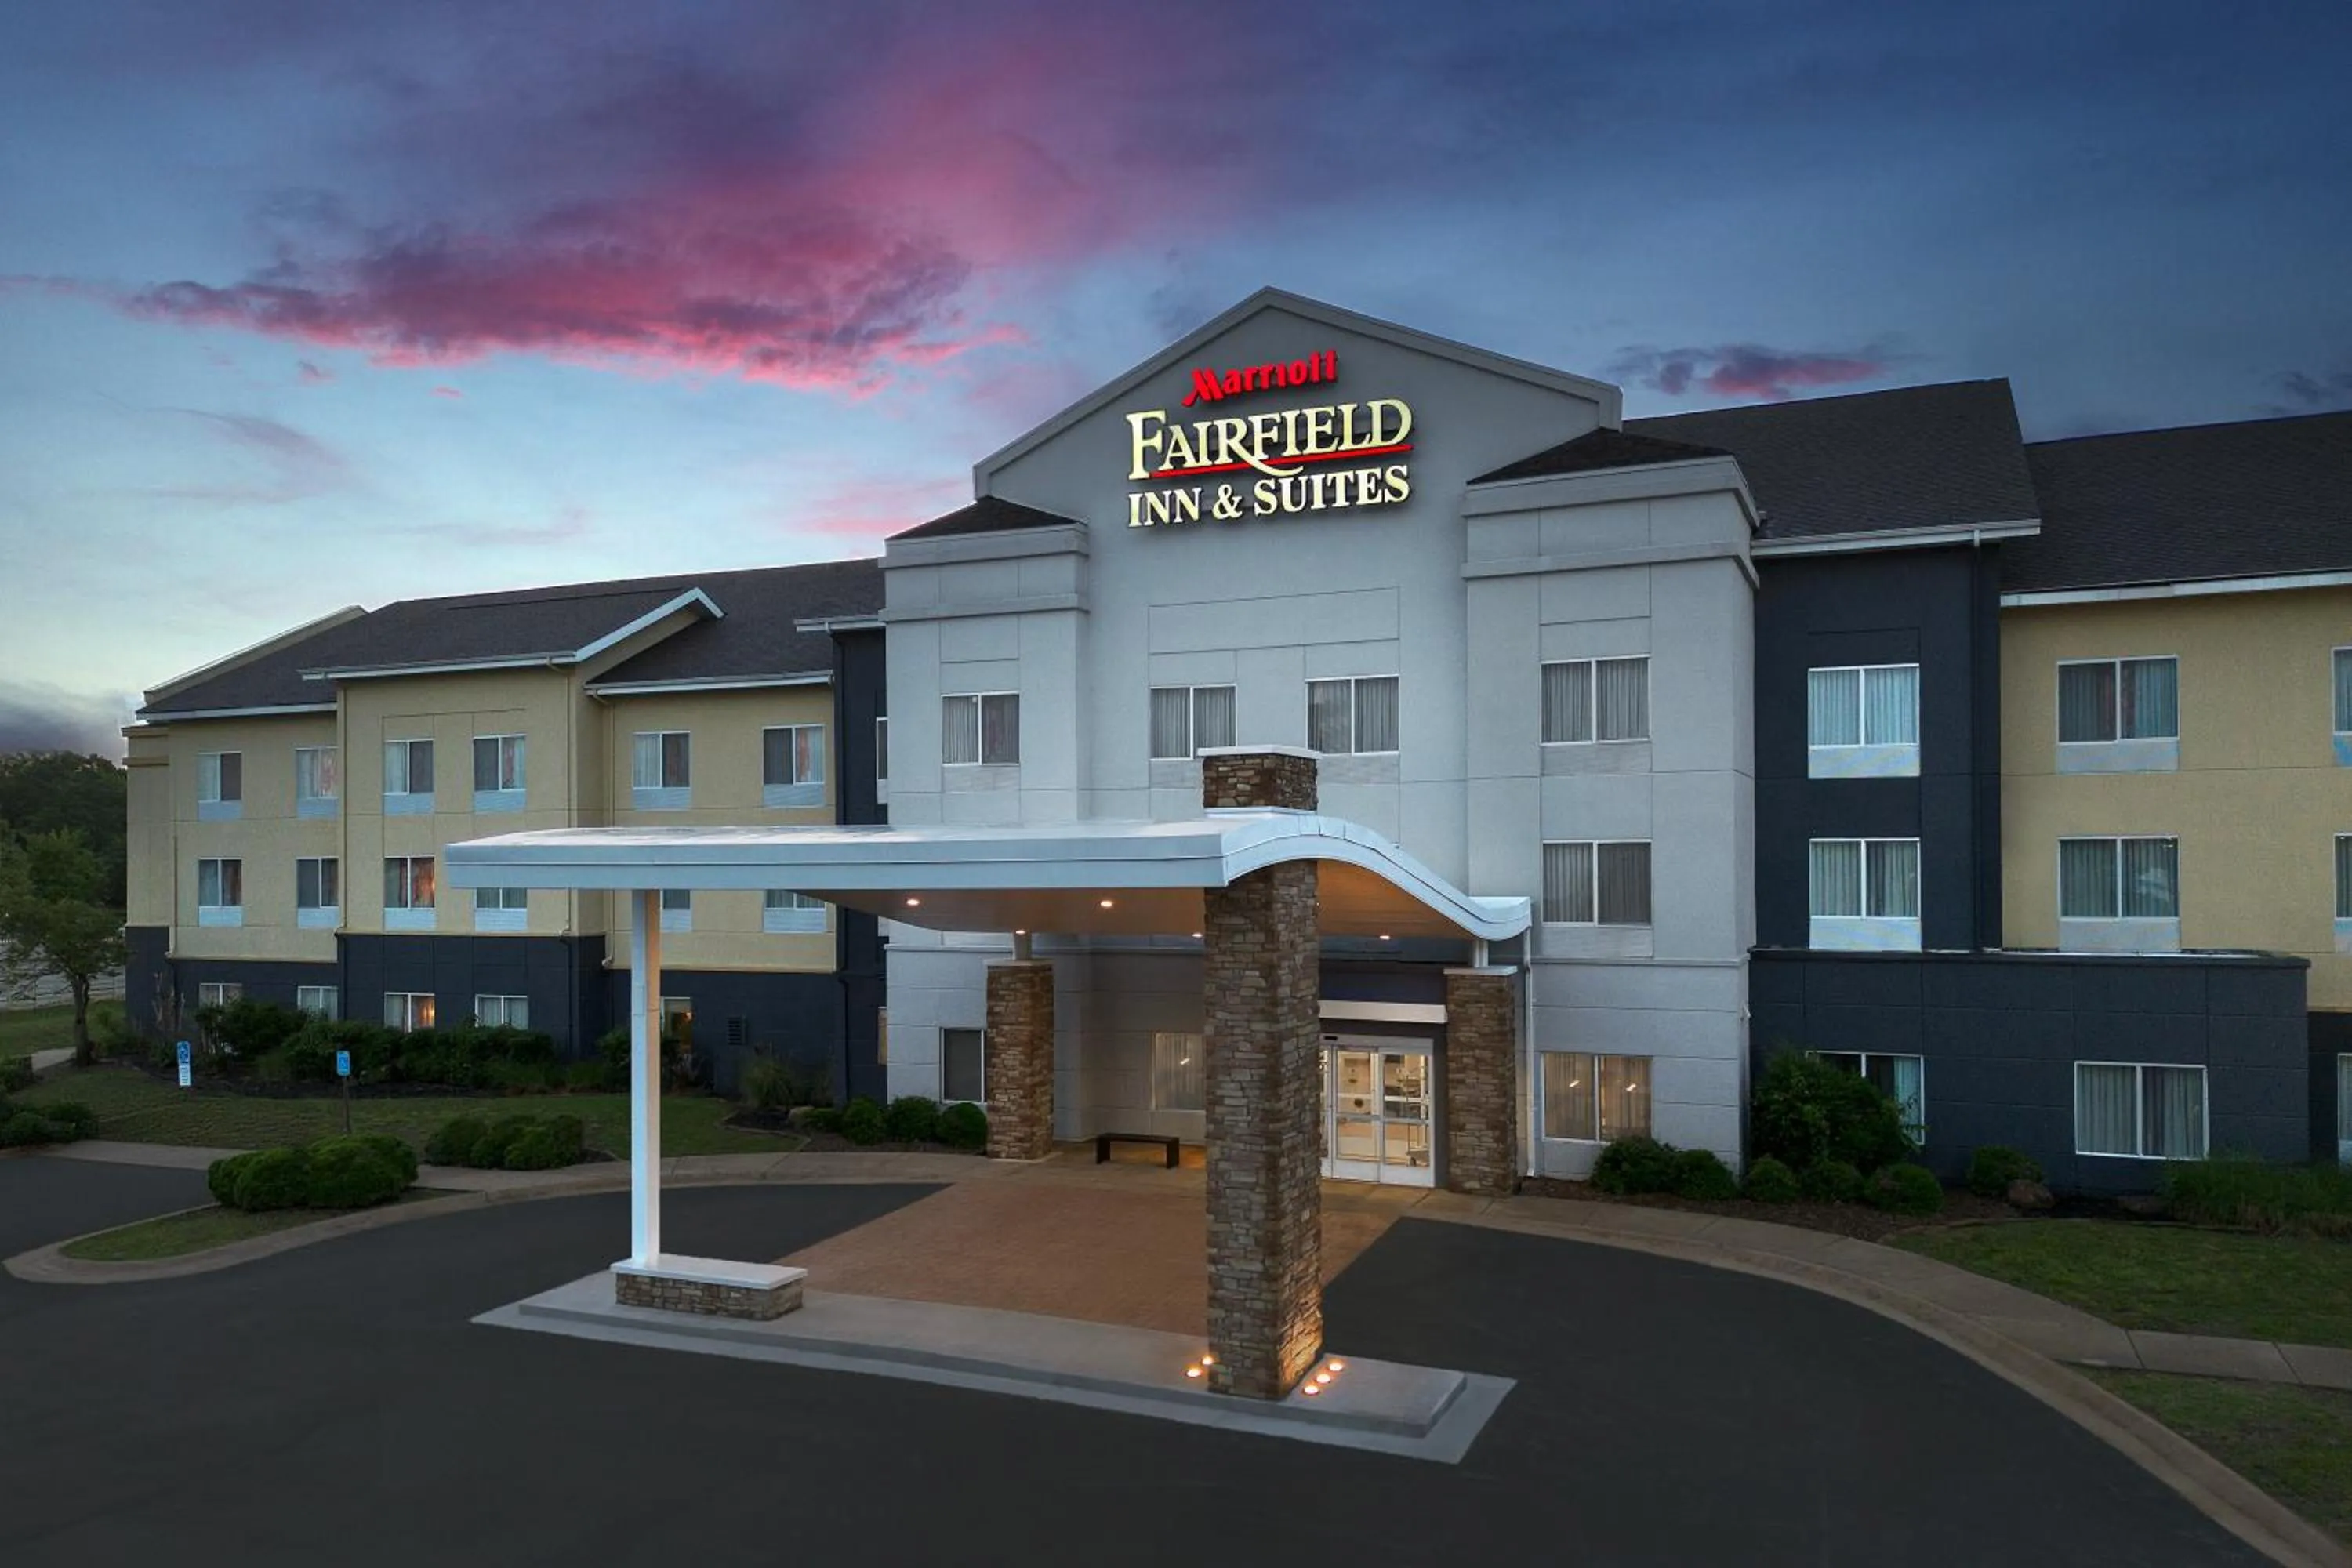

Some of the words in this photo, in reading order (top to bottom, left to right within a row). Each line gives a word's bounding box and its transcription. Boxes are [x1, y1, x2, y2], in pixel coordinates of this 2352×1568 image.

[1181, 350, 1337, 406] Marriott
[1126, 398, 1413, 480] FAIRFIELD
[1129, 487, 1201, 527] INN
[1212, 484, 1243, 521] &
[1254, 464, 1410, 516] SUITES
